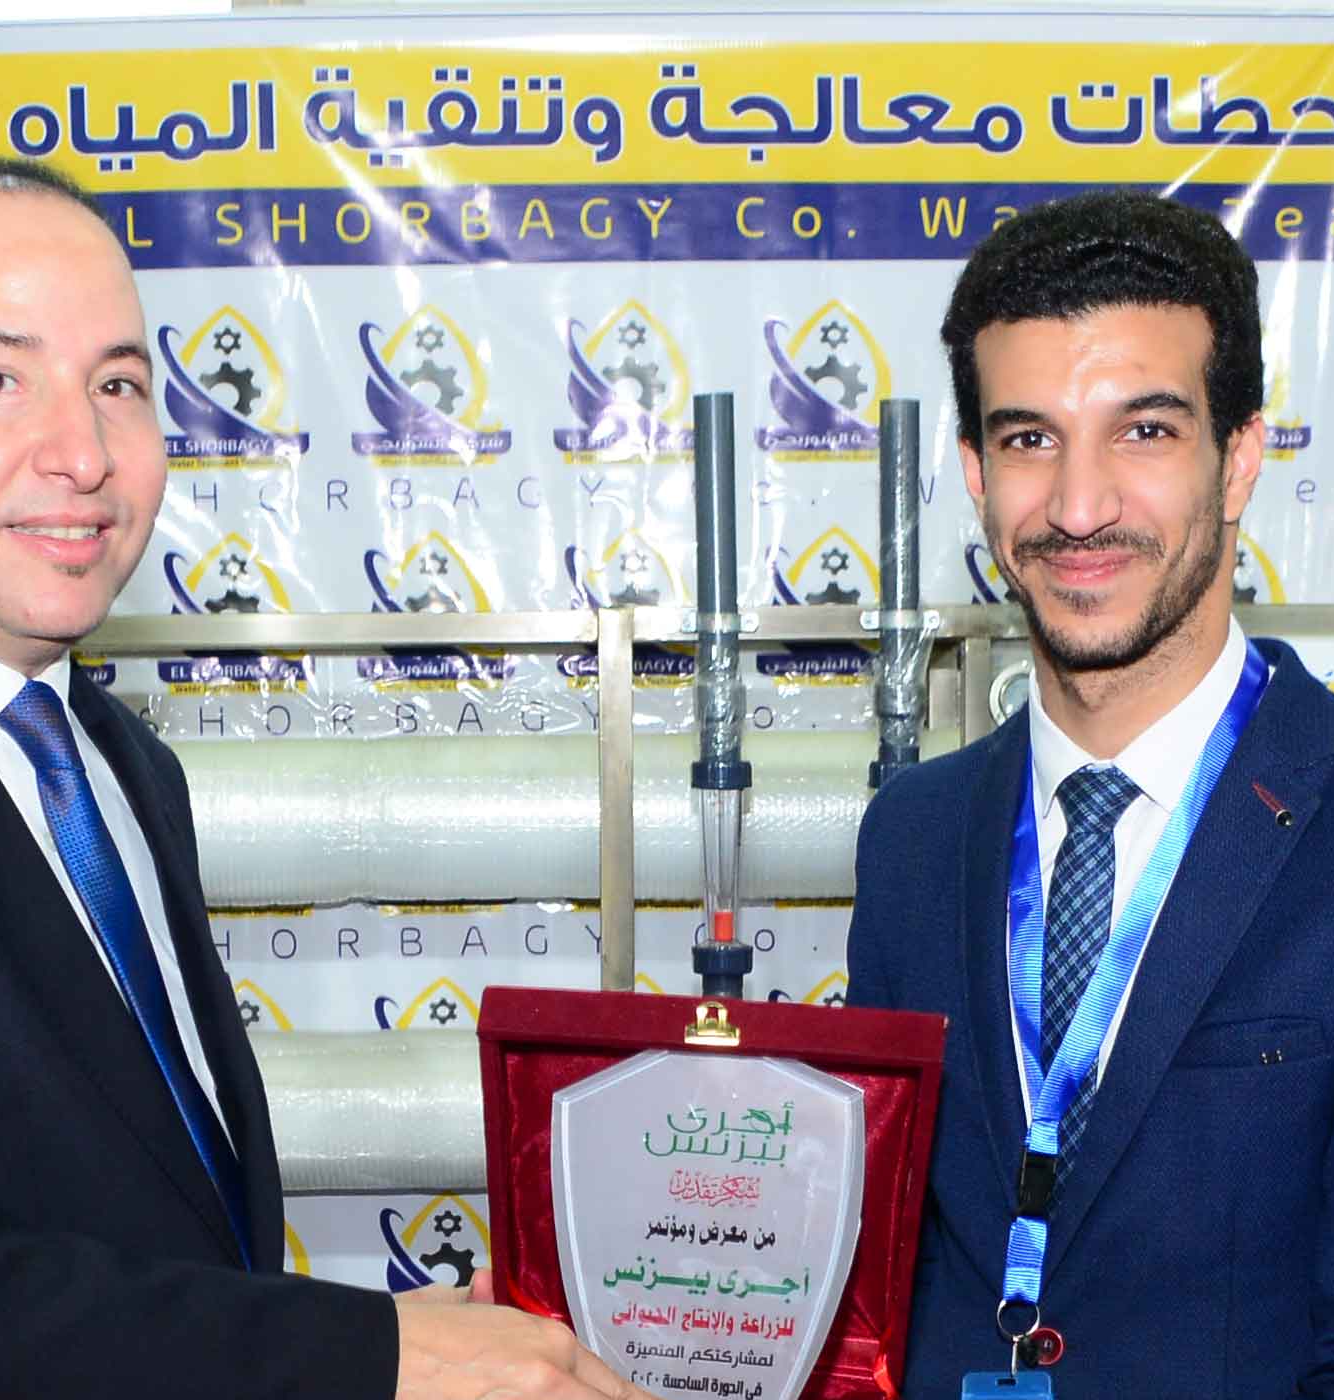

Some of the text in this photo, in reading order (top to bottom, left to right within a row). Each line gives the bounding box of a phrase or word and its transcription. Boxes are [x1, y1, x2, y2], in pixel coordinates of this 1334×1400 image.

[9, 81, 277, 172] المياه
[304, 67, 623, 168] وتنقية
[650, 64, 1023, 163] معالجة
[216, 198, 673, 245] SHORBAGY
[736, 197, 859, 239] Co.
[193, 476, 604, 513] HORBAGY
[212, 922, 602, 959] HORBAGY
[699, 1221, 748, 1246] معرض
[754, 1227, 776, 1250] من
[603, 1255, 711, 1296] بيزنس
[625, 1340, 774, 1369] لمشاركتكم المتميزة
[711, 1376, 744, 1397] الدورة
